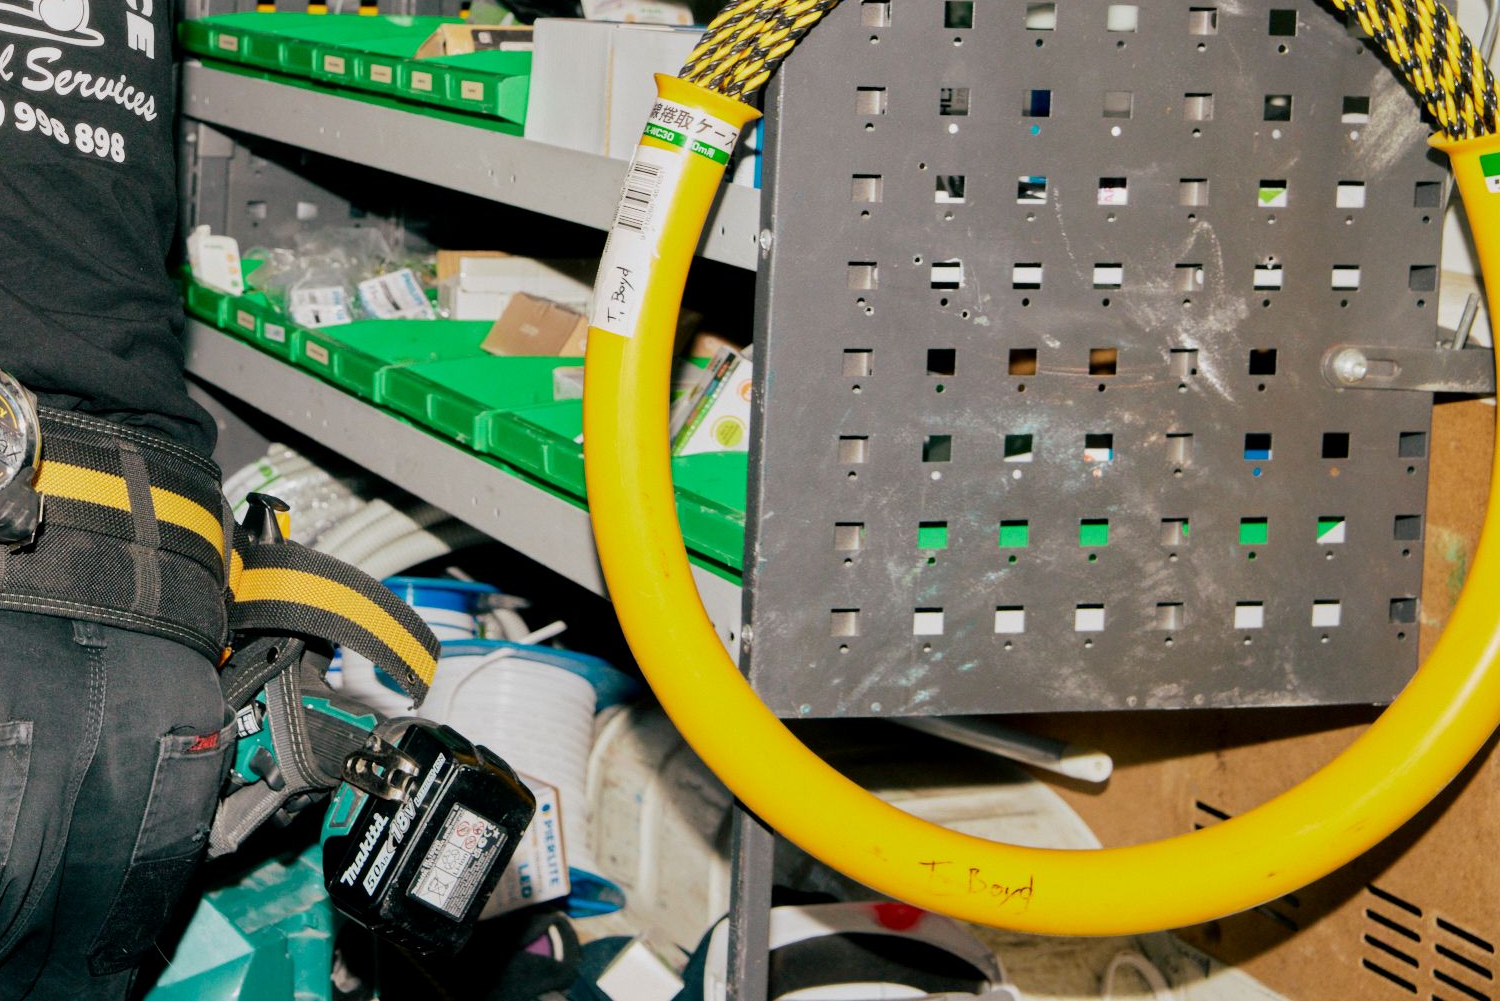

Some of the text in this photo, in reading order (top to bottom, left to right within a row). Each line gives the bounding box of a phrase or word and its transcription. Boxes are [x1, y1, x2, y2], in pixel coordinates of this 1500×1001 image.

[22, 47, 158, 122] Services
[15, 104, 70, 144] 998
[75, 128, 126, 163] 898
[611, 266, 635, 304] Boyd
[389, 798, 417, 843] 18V
[517, 862, 533, 899] LED
[968, 867, 1034, 909] Boyd
